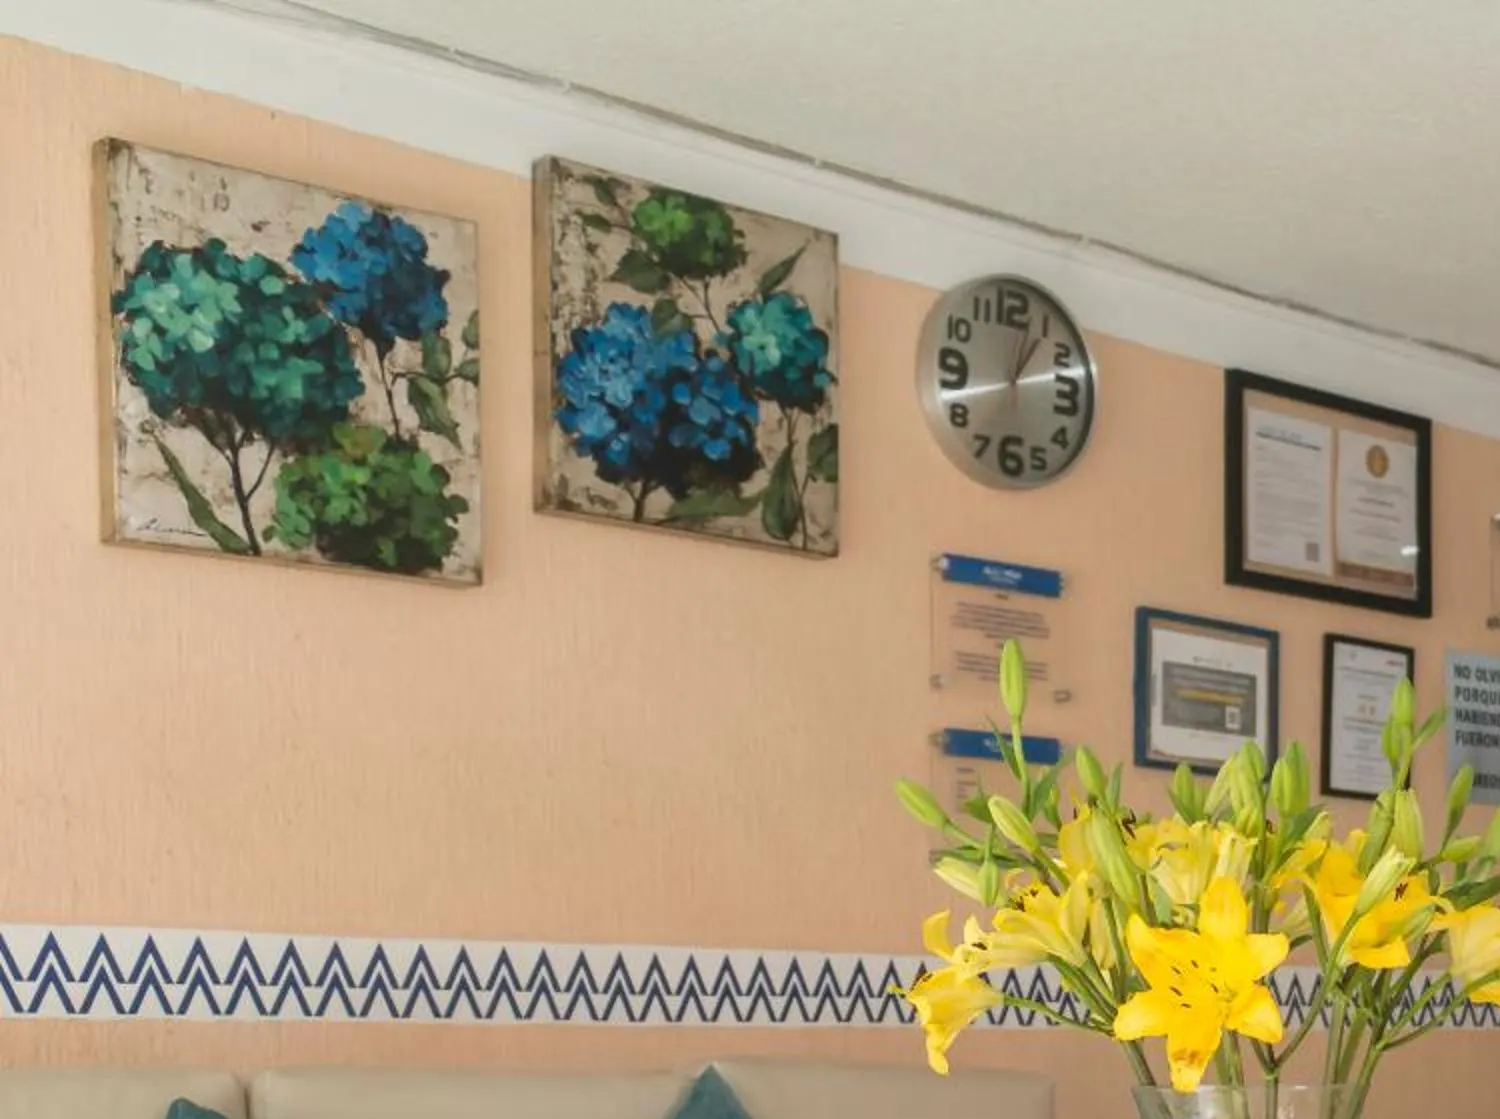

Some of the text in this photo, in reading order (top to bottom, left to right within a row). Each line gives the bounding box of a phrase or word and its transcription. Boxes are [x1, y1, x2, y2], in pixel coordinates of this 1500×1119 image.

[974, 296, 991, 324] 11
[997, 286, 1030, 330] 12
[948, 314, 972, 343] 10
[1041, 313, 1049, 338] 1
[1053, 342, 1072, 368] 2
[938, 346, 969, 391] 9
[1053, 373, 1080, 417] 3
[949, 402, 969, 428] 8
[972, 433, 991, 460] 7
[1050, 425, 1069, 450] 4
[997, 434, 1025, 478] 6
[1029, 446, 1048, 471] 5
[1454, 664, 1471, 680] NO
[1455, 730, 1500, 748] FUERON
